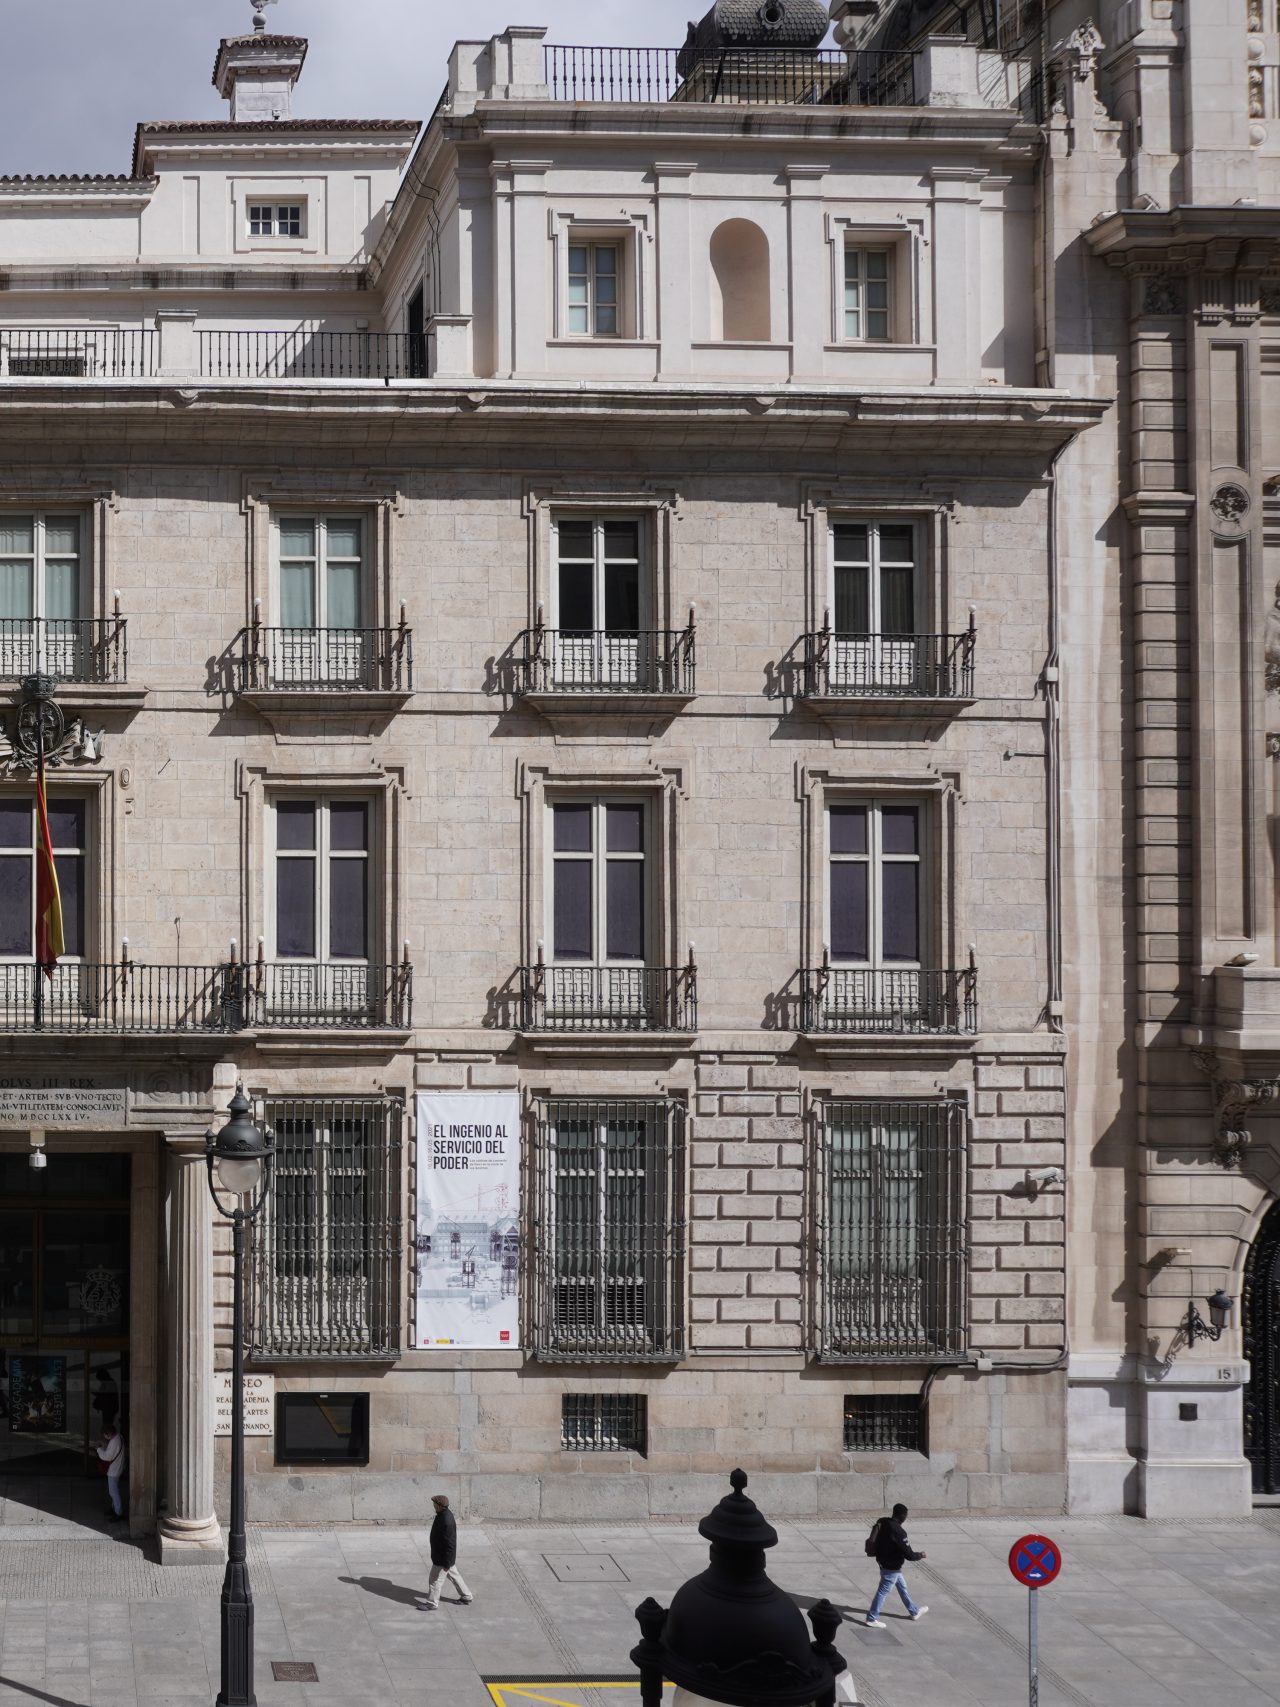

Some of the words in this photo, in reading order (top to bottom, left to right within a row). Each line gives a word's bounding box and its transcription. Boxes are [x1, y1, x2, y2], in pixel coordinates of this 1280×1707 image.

[42, 1078, 59, 1089] III
[69, 1078, 96, 1089] REX
[433, 1124, 447, 1138] EL
[449, 1124, 492, 1138] INGENIO
[495, 1124, 509, 1138] AL
[433, 1140, 482, 1154] SERVICIO
[485, 1140, 505, 1154] DEL
[433, 1156, 469, 1170] PODER
[1218, 1368, 1232, 1380] 15
[223, 1378, 263, 1388] MSEO
